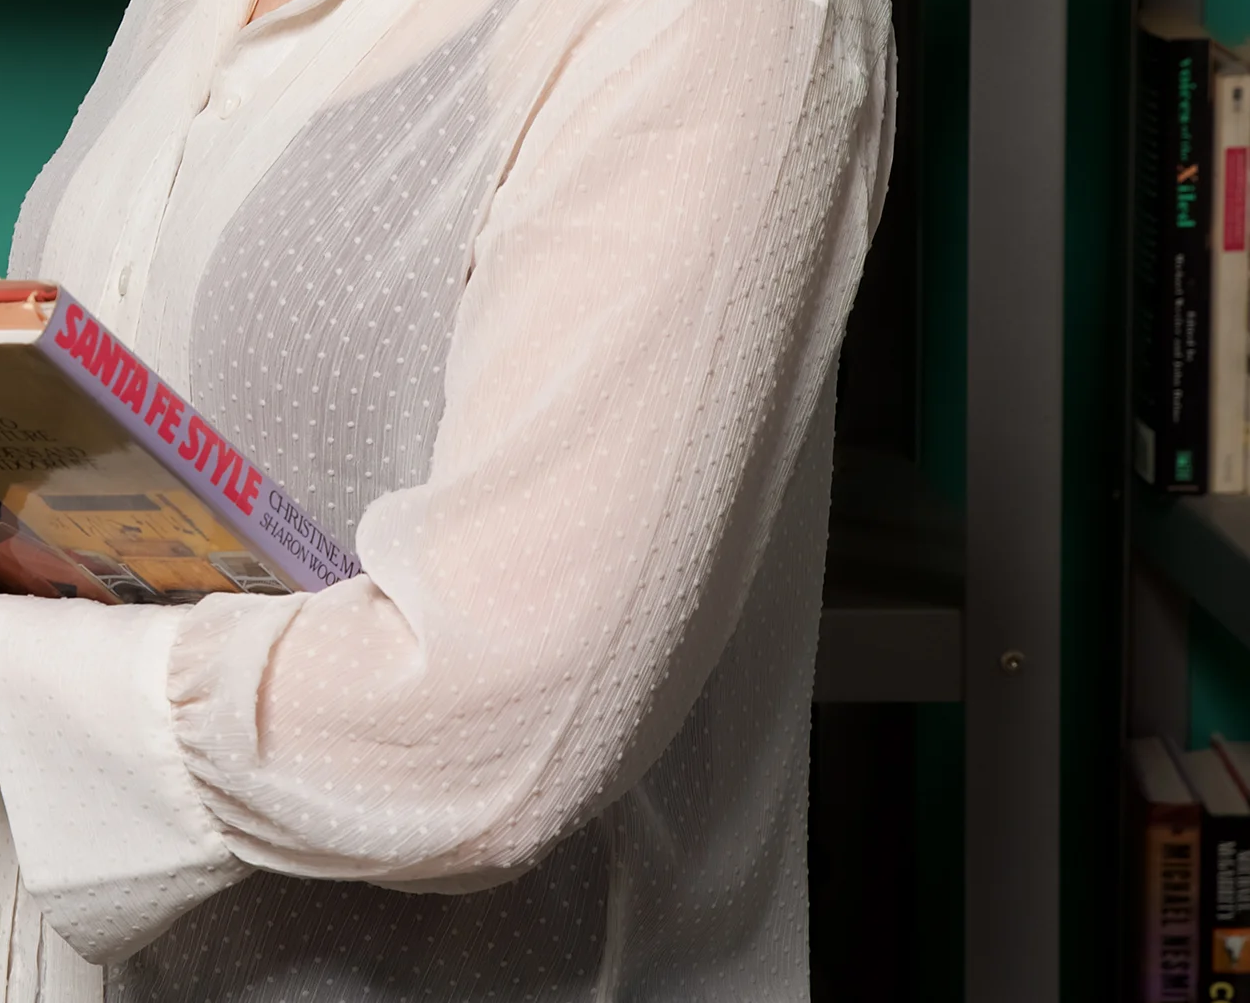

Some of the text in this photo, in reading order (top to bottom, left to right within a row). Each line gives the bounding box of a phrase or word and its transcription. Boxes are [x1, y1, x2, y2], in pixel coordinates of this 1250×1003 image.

[53, 303, 263, 516] SANTA FE STYLE
[44, 447, 93, 460] AND
[260, 512, 308, 564] SHARON
[268, 490, 344, 568] CHRISTINE
[1162, 843, 1191, 927] MICHAEL
